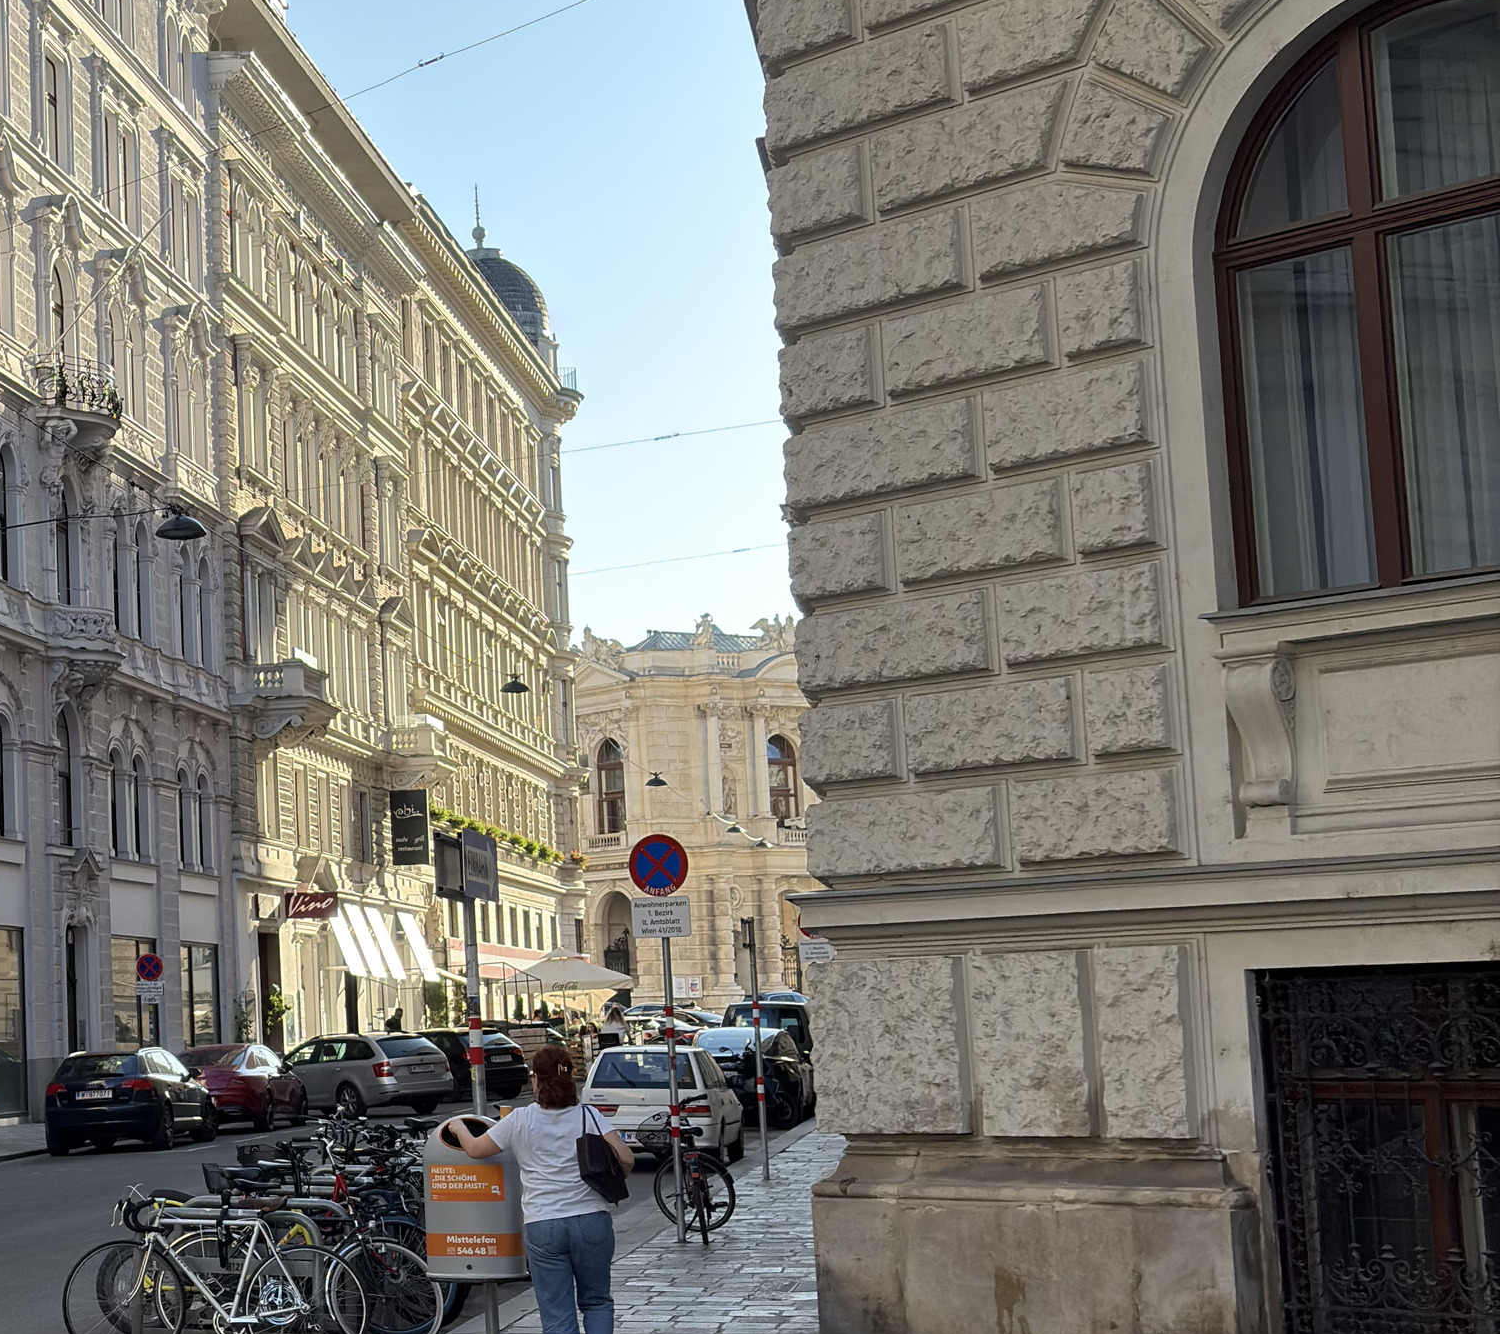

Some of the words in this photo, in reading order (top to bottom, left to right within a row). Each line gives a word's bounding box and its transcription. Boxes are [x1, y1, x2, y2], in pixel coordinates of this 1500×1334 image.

[414, 835, 425, 844] grill
[643, 883, 676, 896] ANFANG
[288, 895, 334, 917] Vino
[634, 900, 687, 908] Anwohnerparken
[654, 909, 674, 917] Bezirk
[641, 927, 657, 935] Wien
[658, 926, 682, 934] 41/2018
[446, 1236, 496, 1244] Misttelefon
[457, 1247, 473, 1255] 546
[474, 1247, 486, 1255] 48
